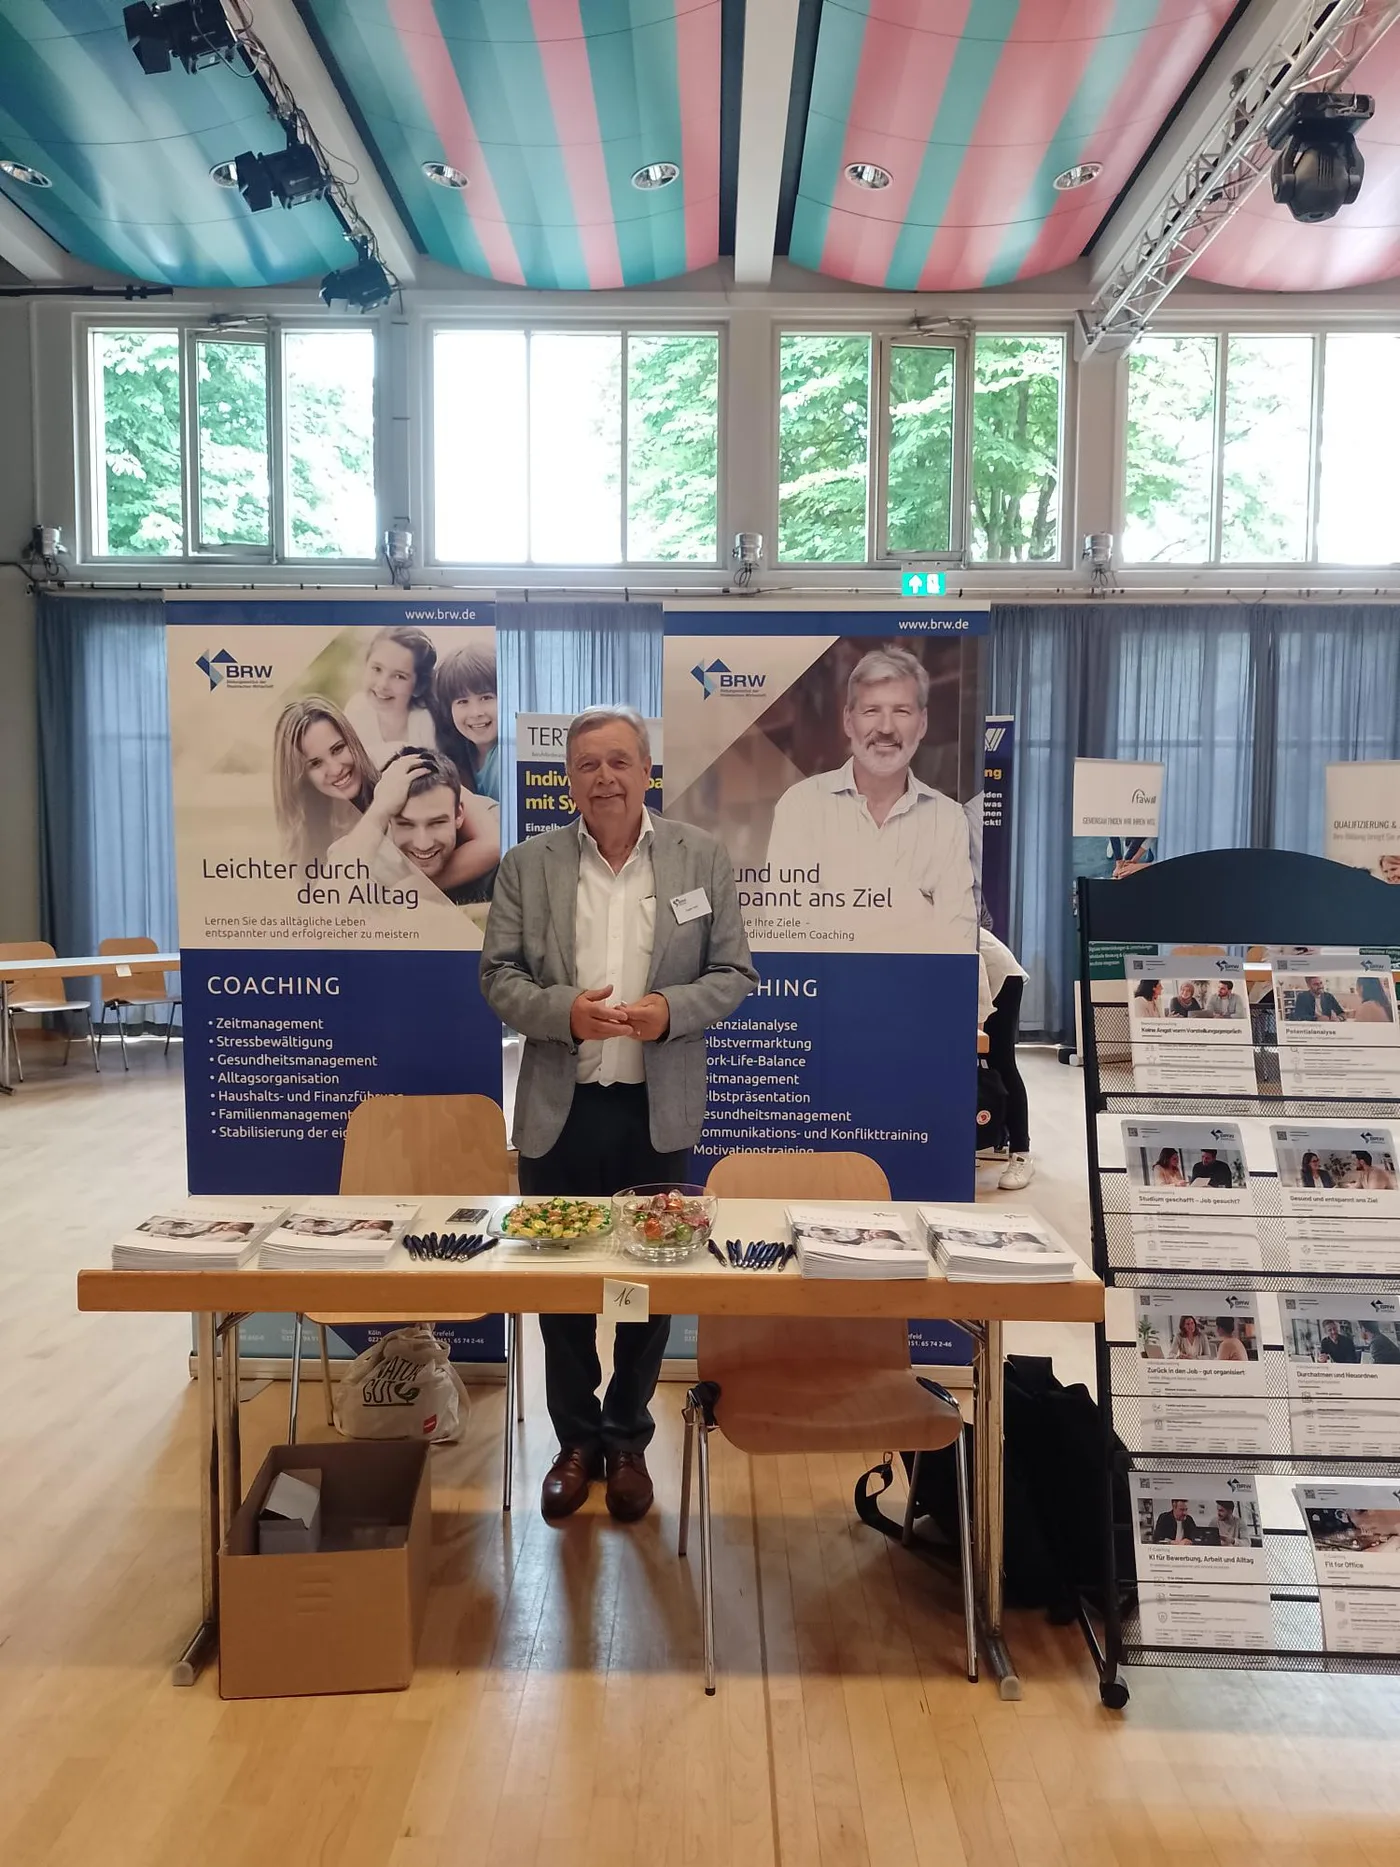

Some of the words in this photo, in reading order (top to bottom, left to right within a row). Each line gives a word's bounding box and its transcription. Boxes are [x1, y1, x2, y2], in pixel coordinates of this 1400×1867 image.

[405, 609, 476, 620] www.brw.de
[899, 619, 969, 630] www.brw.de
[226, 666, 272, 678] BRW
[721, 675, 766, 687] BRW
[527, 727, 568, 746] TER
[525, 770, 571, 786] Indiv
[984, 769, 1002, 780] ng
[525, 794, 554, 810] mit
[559, 795, 576, 814] Sy
[1334, 820, 1389, 829] QUALIFIZIERUNG
[203, 858, 298, 879] Leichter
[305, 858, 370, 879] durch
[732, 862, 770, 882] und
[779, 863, 820, 884] und
[297, 883, 340, 905] den
[348, 883, 419, 909] Alltag
[739, 889, 801, 909] pannt
[809, 891, 845, 908] ans
[852, 888, 893, 909] Ziel
[205, 916, 240, 926] Lernen
[243, 916, 258, 926] Sie
[261, 916, 277, 926] das
[280, 916, 332, 928] alltägliche
[335, 917, 366, 926] Leben
[755, 918, 774, 926] Ihre
[777, 919, 801, 927] Ziele
[206, 929, 266, 940] entspannter
[269, 929, 289, 938] und
[292, 929, 357, 940] erfolgreicher
[374, 929, 419, 939] meistern
[809, 929, 855, 941] Coaching
[207, 976, 340, 995] COACHING
[747, 979, 817, 997] HING
[216, 1018, 323, 1031] Zeitmanagement
[704, 1019, 797, 1033] tenzialanalyse
[217, 1036, 333, 1050] Stressbewältigung
[705, 1037, 812, 1051] elbstvermarktung
[218, 1054, 378, 1068] Gesundheitsmanagement
[707, 1054, 806, 1067] ork-Life-Balance
[218, 1072, 339, 1086] Alltagsorganisation
[705, 1073, 799, 1086] eitmanagement
[218, 1090, 284, 1102] Haushalts-
[287, 1091, 310, 1102] und
[219, 1108, 352, 1121] Familienmanagement
[704, 1109, 852, 1122] esundheitsmanagement
[219, 1127, 304, 1140] Stabilisierung
[307, 1127, 328, 1139] der
[700, 1127, 801, 1139] ommunikations-
[805, 1128, 827, 1140] und
[831, 1128, 928, 1143] Konflikttraining
[614, 1288, 634, 1306] 16
[362, 1379, 396, 1403] GUT
[1167, 1555, 1202, 1563] Bewerbung,
